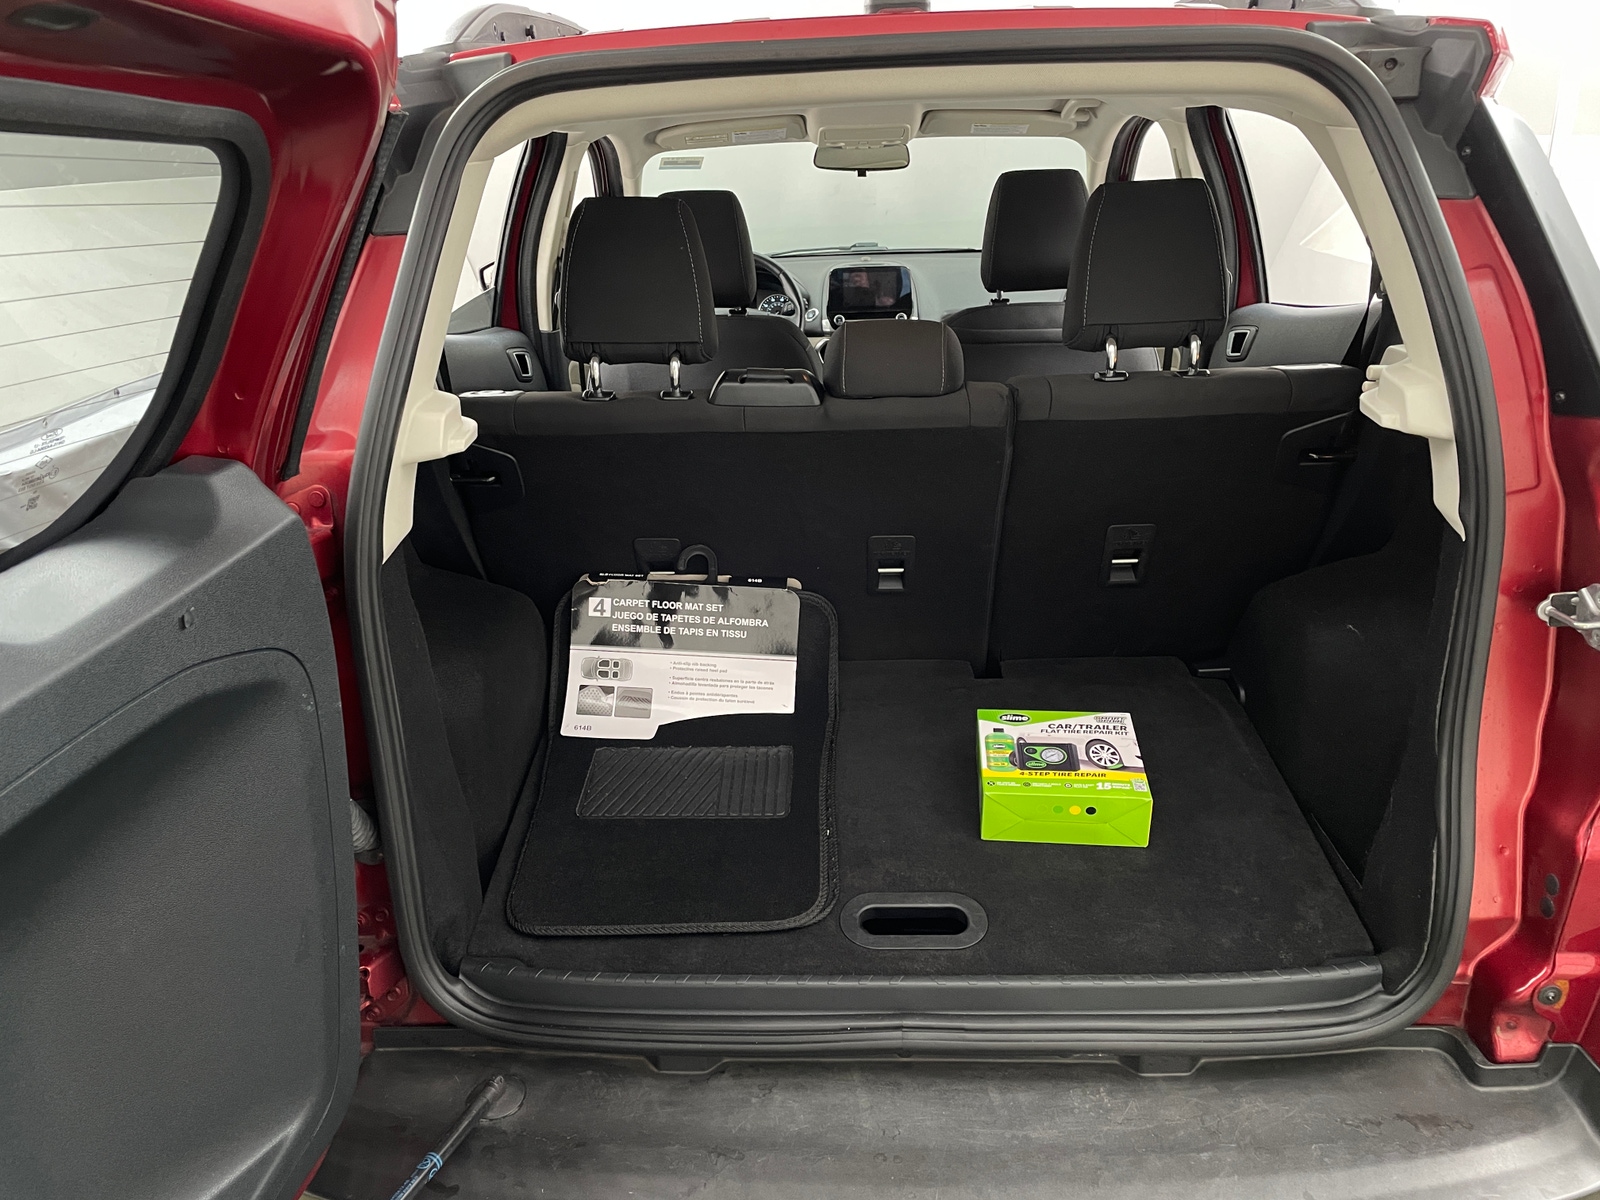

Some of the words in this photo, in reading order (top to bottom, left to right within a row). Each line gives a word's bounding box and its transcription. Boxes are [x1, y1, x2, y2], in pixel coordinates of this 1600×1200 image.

[594, 599, 606, 616] 4
[613, 598, 649, 608] CARPET
[652, 600, 682, 610] FLOOR
[684, 602, 704, 611] MAT
[706, 604, 724, 612] SET
[612, 612, 644, 621] JUEGO
[646, 613, 658, 622] DE
[661, 614, 700, 624] TAPETES
[703, 616, 715, 624] DE
[718, 617, 769, 627] ALFOMBRA
[612, 624, 661, 634] ENSEMBLE
[663, 626, 676, 634] DE
[678, 627, 704, 636] TAPIS
[706, 628, 718, 637] EN
[720, 629, 747, 638] TISSU
